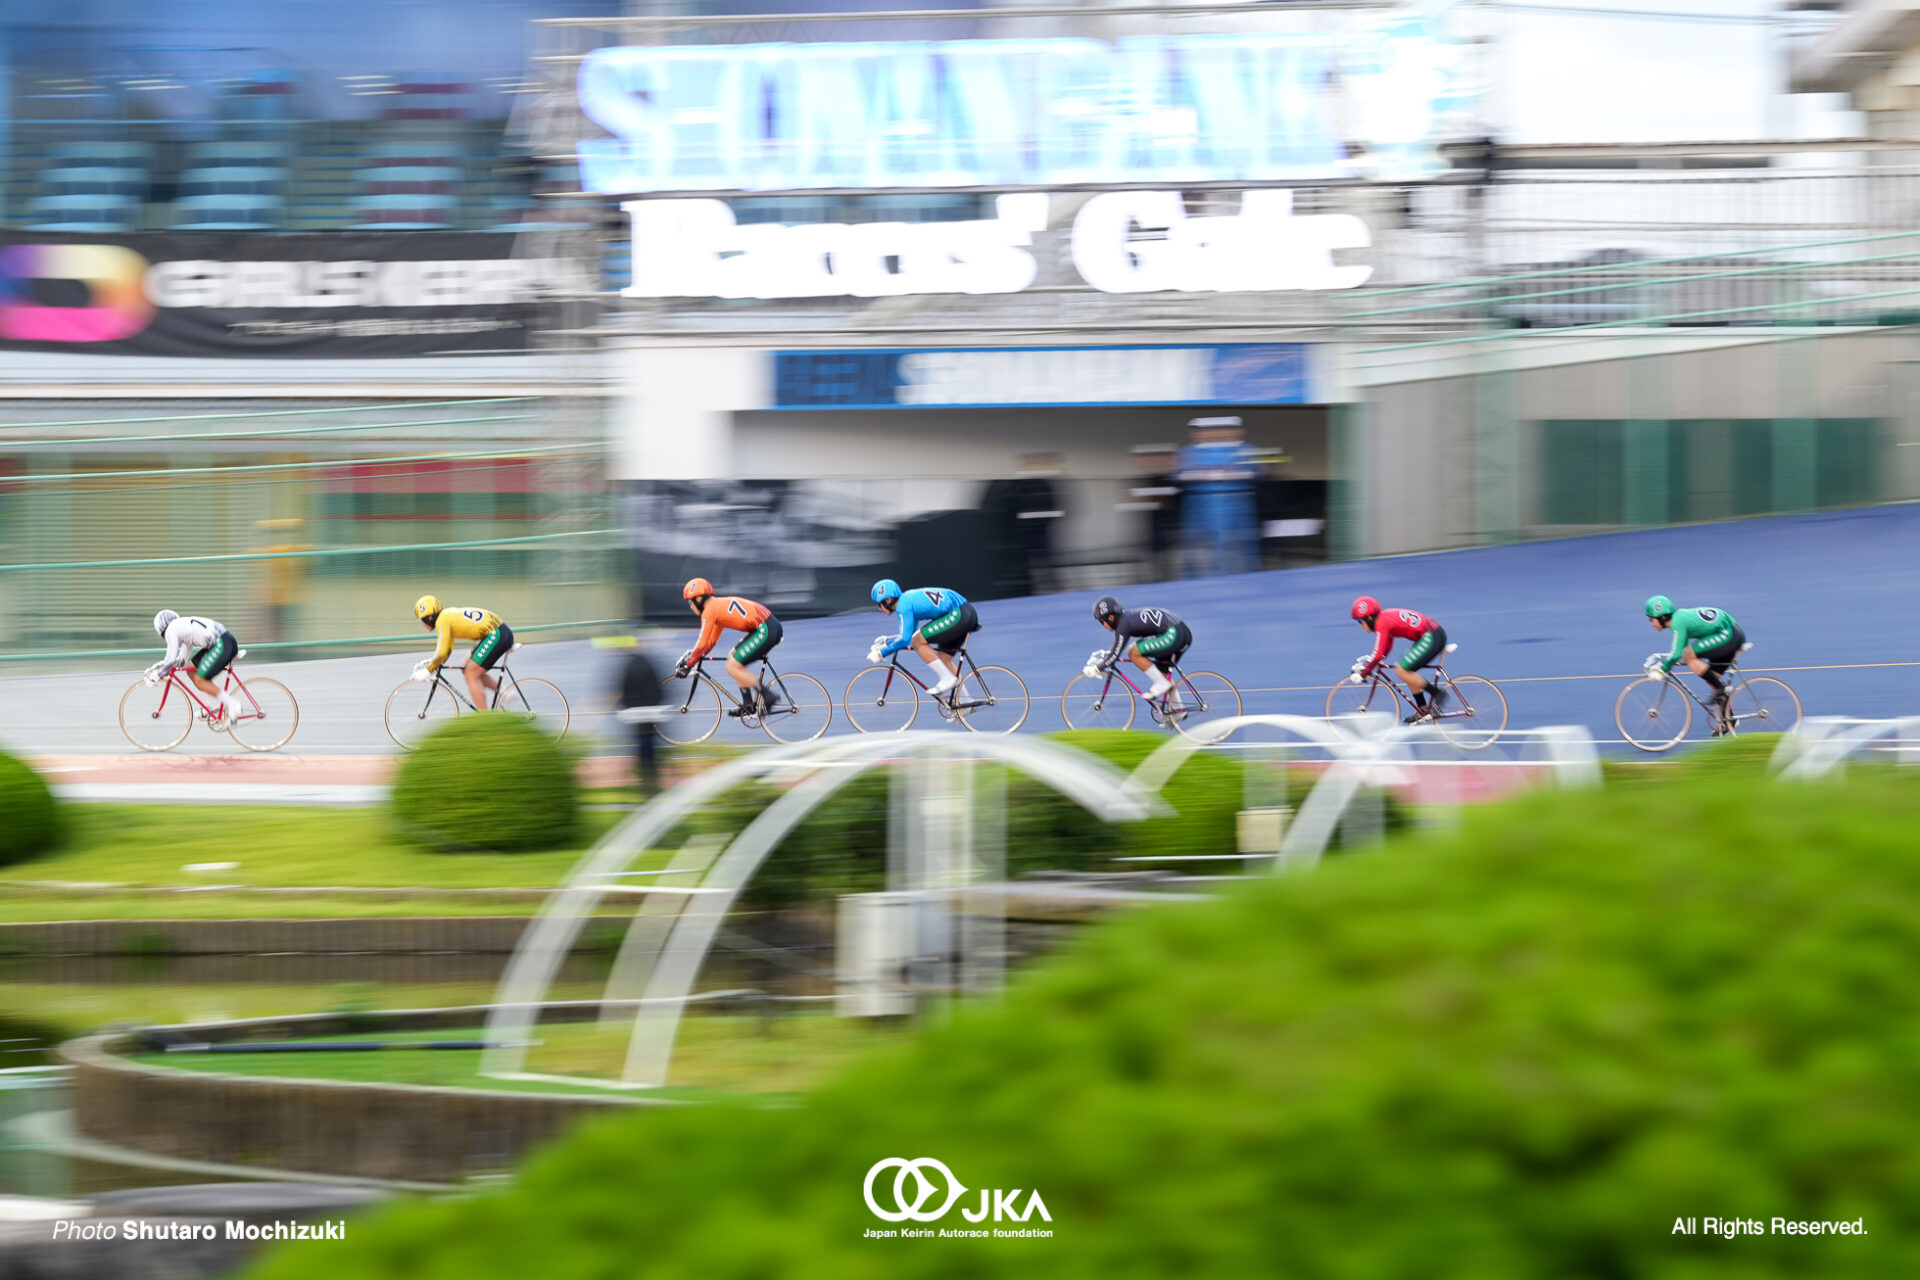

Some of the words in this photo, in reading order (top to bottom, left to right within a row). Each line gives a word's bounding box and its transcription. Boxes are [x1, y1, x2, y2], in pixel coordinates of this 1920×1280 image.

[924, 589, 945, 607] 4
[463, 606, 485, 623] 5
[728, 599, 748, 618] 7
[1140, 608, 1164, 627] 2
[1697, 606, 1719, 624] 6
[190, 618, 208, 630] 1
[1398, 609, 1422, 628] 3
